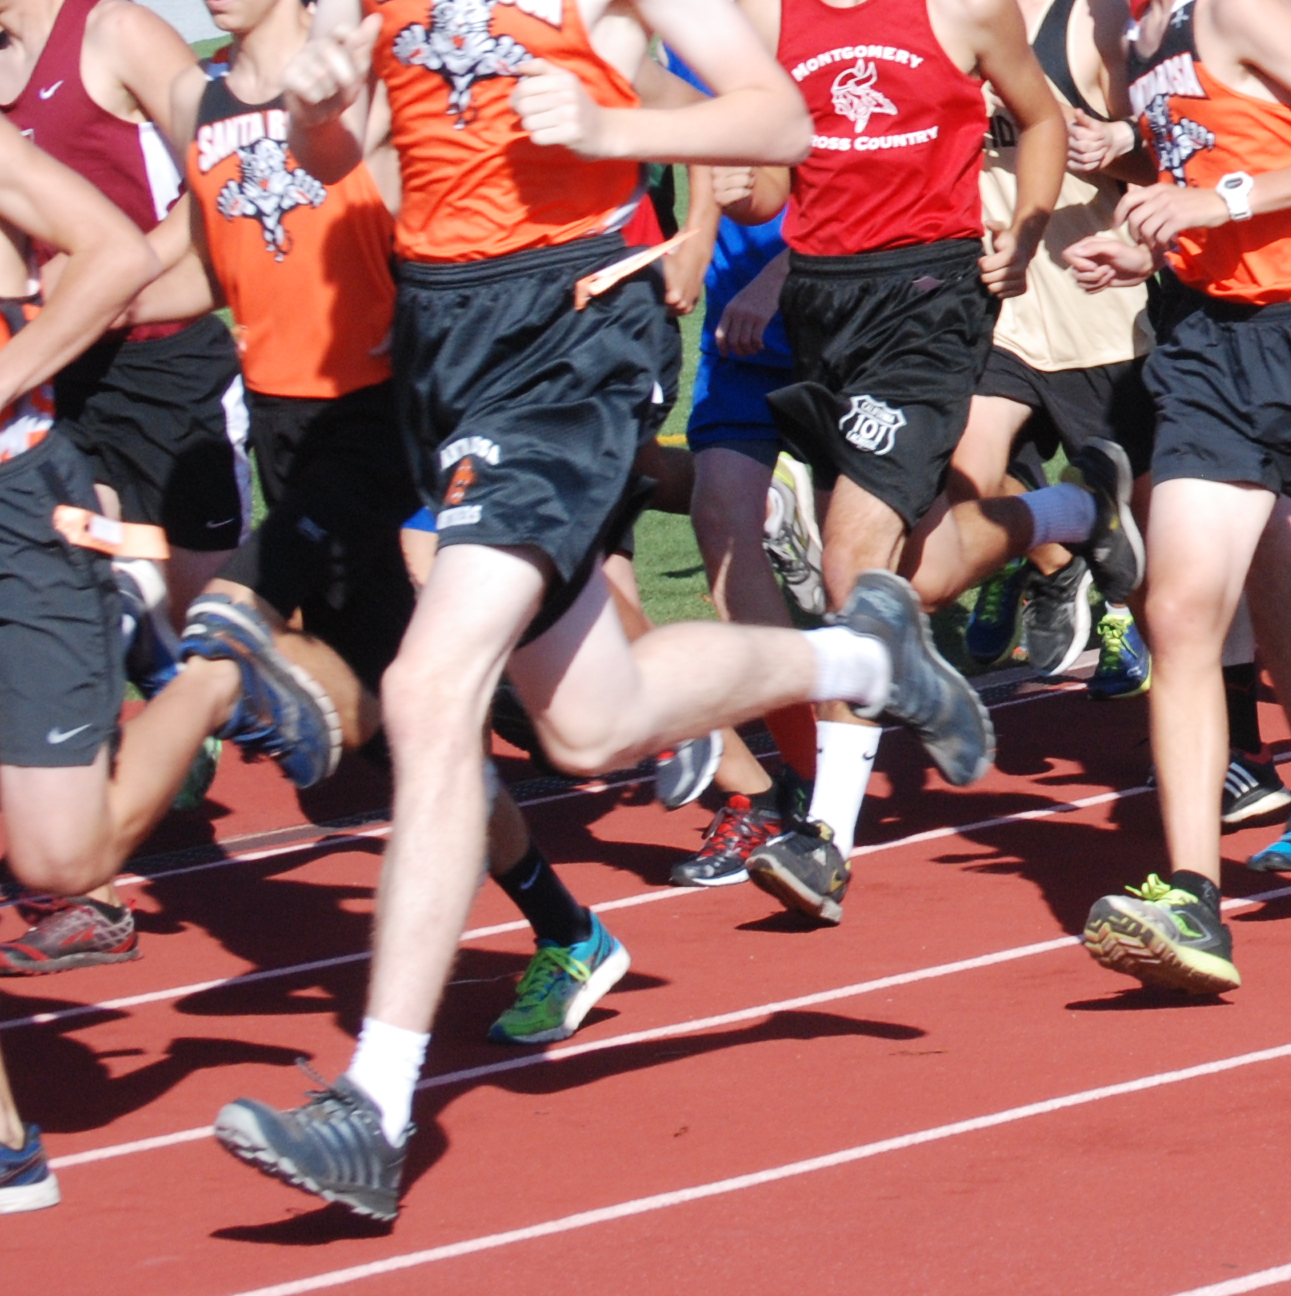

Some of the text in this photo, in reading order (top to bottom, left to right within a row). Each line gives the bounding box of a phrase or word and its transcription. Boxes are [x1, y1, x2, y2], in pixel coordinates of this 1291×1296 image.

[790, 44, 925, 83] MONTGOMERY
[197, 110, 266, 172] SANTA
[810, 125, 940, 152] ROSS COUNTRY
[853, 414, 888, 444] 101
